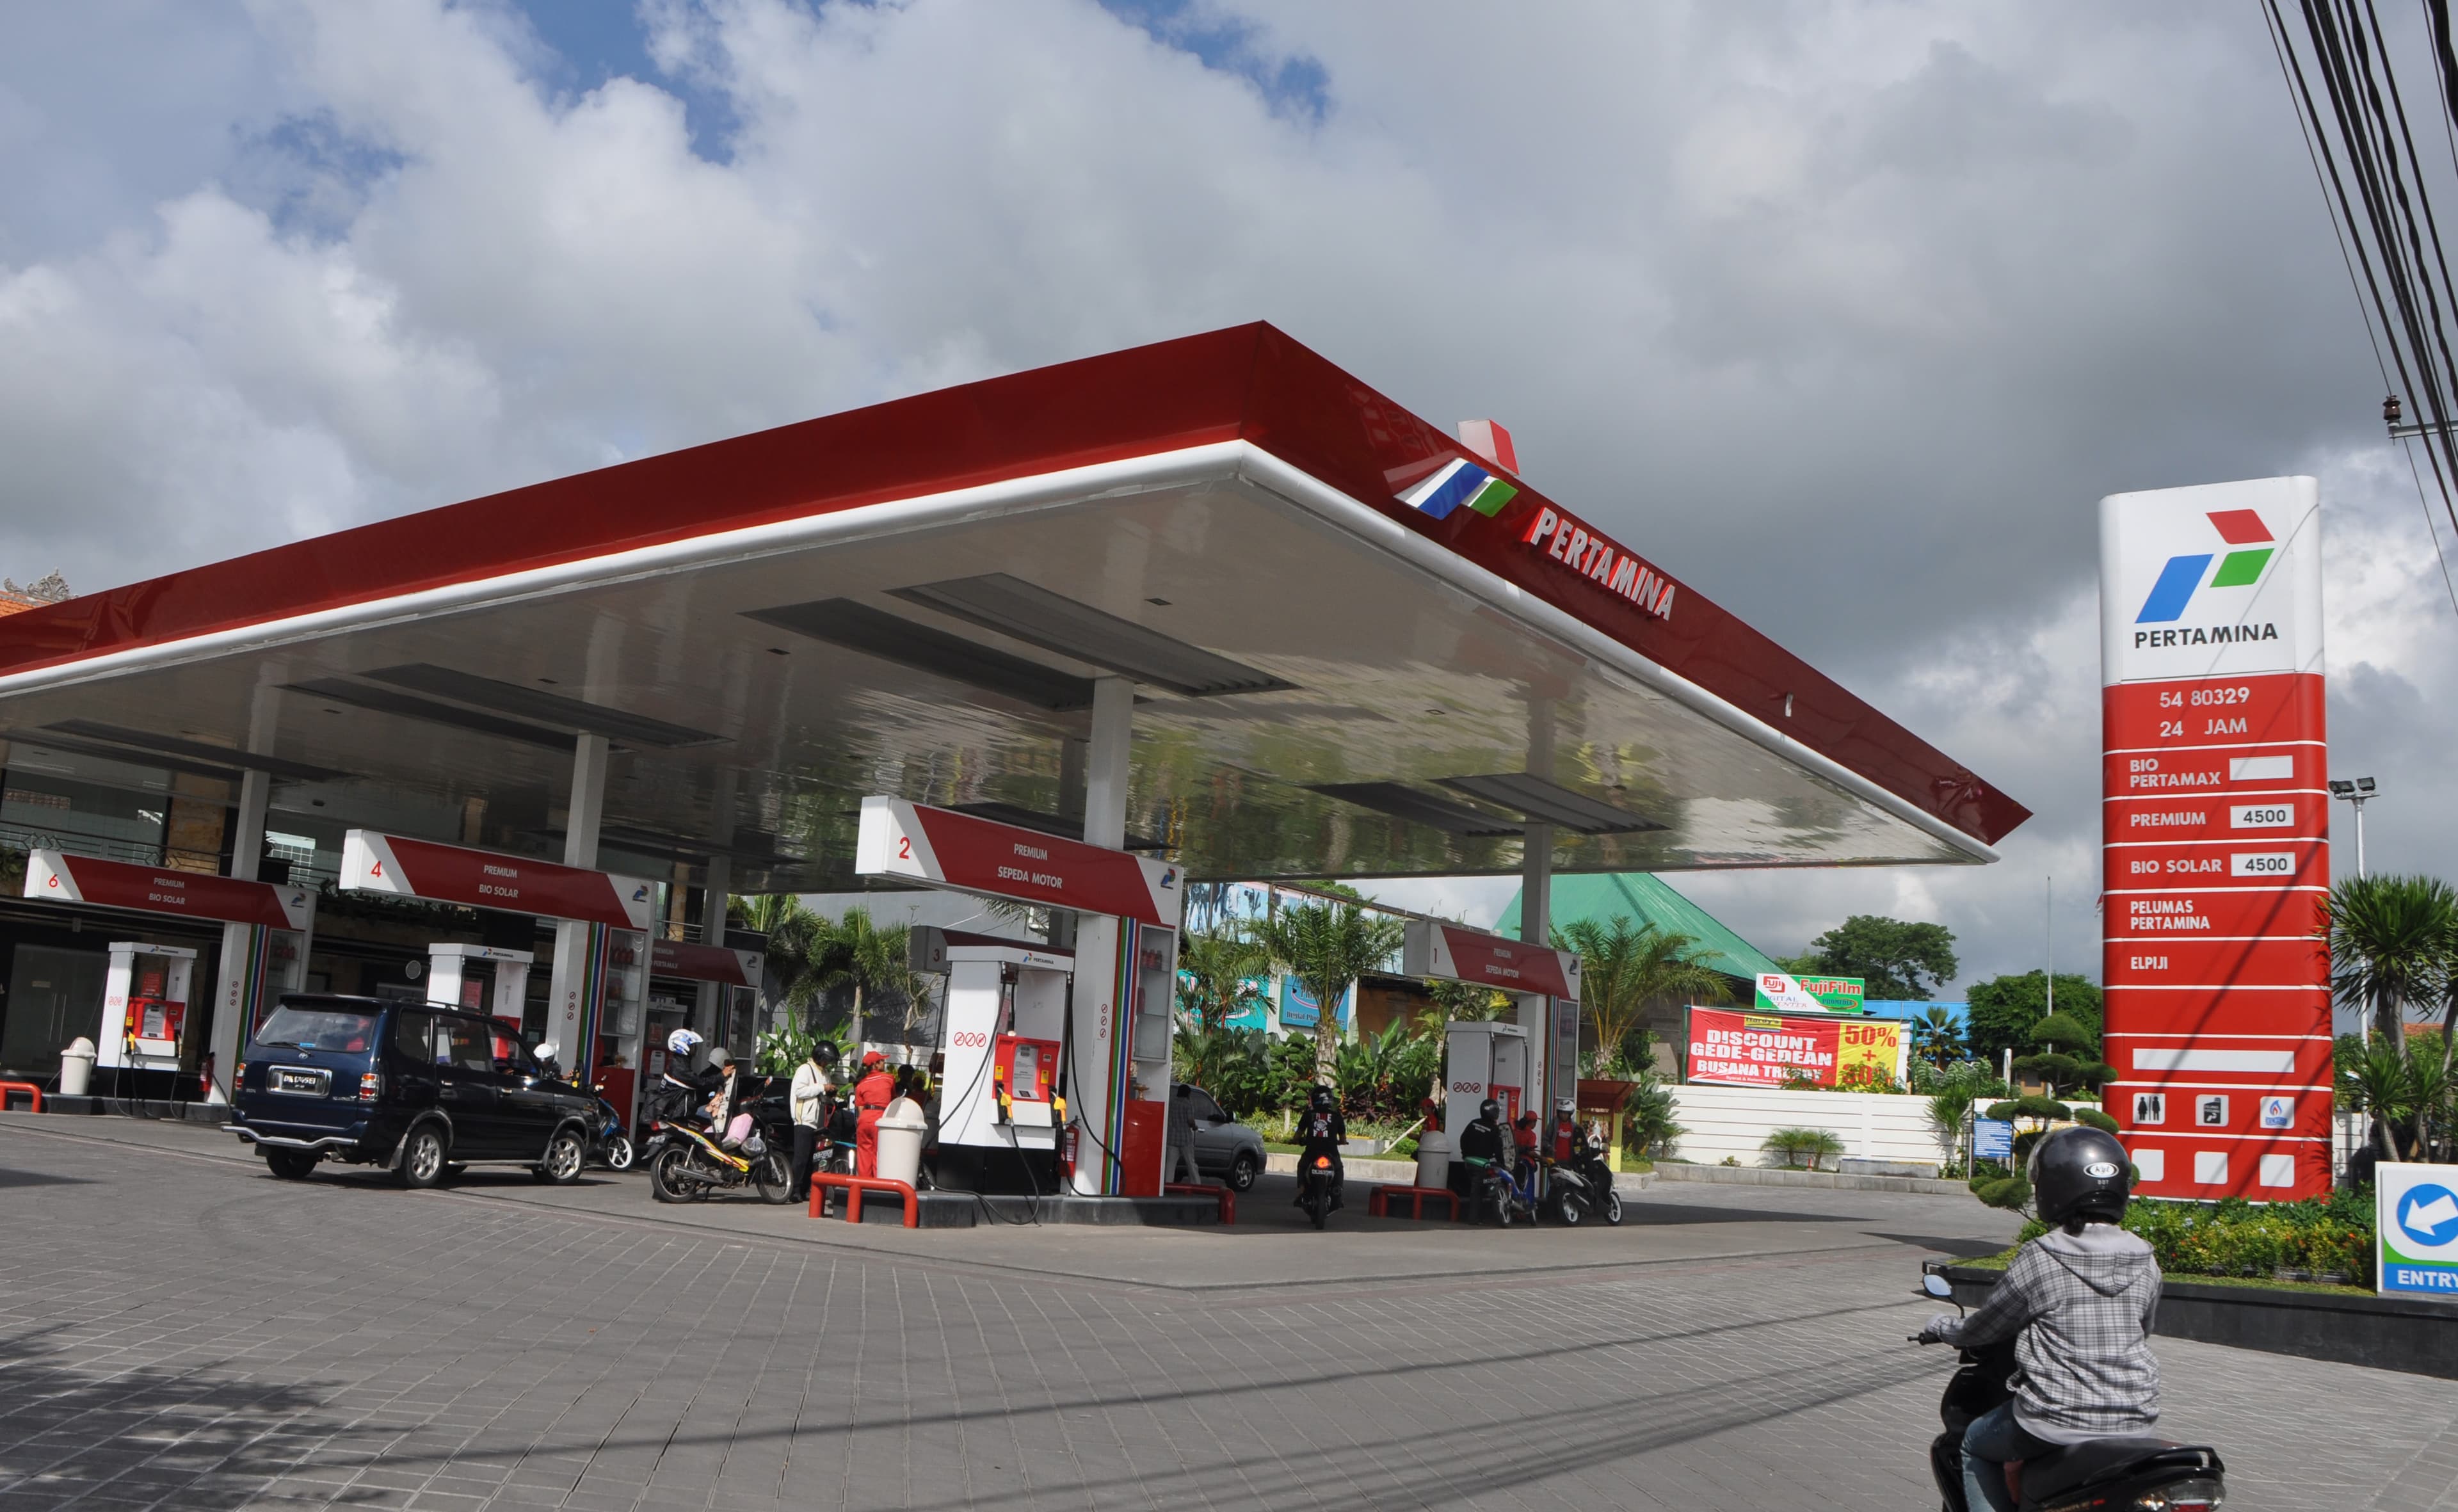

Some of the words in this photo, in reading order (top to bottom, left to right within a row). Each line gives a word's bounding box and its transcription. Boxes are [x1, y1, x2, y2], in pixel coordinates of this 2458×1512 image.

[1528, 506, 1676, 622] PERTAMINA
[2135, 623, 2279, 648] PERTAMINA
[2159, 691, 2183, 708] 54
[2190, 686, 2250, 706] 80329
[2159, 721, 2184, 737] 24
[2204, 718, 2247, 736] JAM
[2130, 758, 2159, 773] BIO
[2130, 771, 2221, 788] PERTAMAX
[2130, 812, 2206, 828] PREMIUM
[2243, 809, 2286, 824] 4500
[899, 836, 911, 860] 2
[1013, 843, 1048, 861] PREMIUM
[371, 860, 382, 878] 4
[483, 865, 518, 878] PREMIUM
[2130, 860, 2160, 874] BIO
[2165, 858, 2223, 873] SOLAR
[2244, 858, 2288, 872] 4500
[49, 873, 59, 888] 6
[153, 877, 185, 889] PREMIUM
[997, 865, 1029, 883] SEPEDA
[1031, 873, 1063, 889] MOTOR
[149, 893, 161, 901] BIO
[163, 895, 186, 905] SOLAR
[478, 883, 493, 894] BIO
[493, 886, 519, 899] SOLAR
[2130, 900, 2194, 915] PELUMAS
[2130, 915, 2210, 930] PERTAMINA
[933, 948, 941, 962] 3
[1433, 947, 1438, 963] 1
[2130, 956, 2168, 970] ELPIJI
[1485, 964, 1502, 976] SEPEDA
[1502, 967, 1520, 979] MOTOR
[1799, 978, 1862, 996] FujiFilm
[1287, 1011, 1305, 1020] Digital
[1745, 1016, 1781, 1025] Hardy's
[1706, 1029, 1817, 1051] DISCOUNT
[1844, 1025, 1897, 1048] 50%
[1690, 1042, 1833, 1066] GEDE-GEDEAN
[1861, 1049, 1877, 1062] +
[1696, 1059, 1760, 1077] BUSANA
